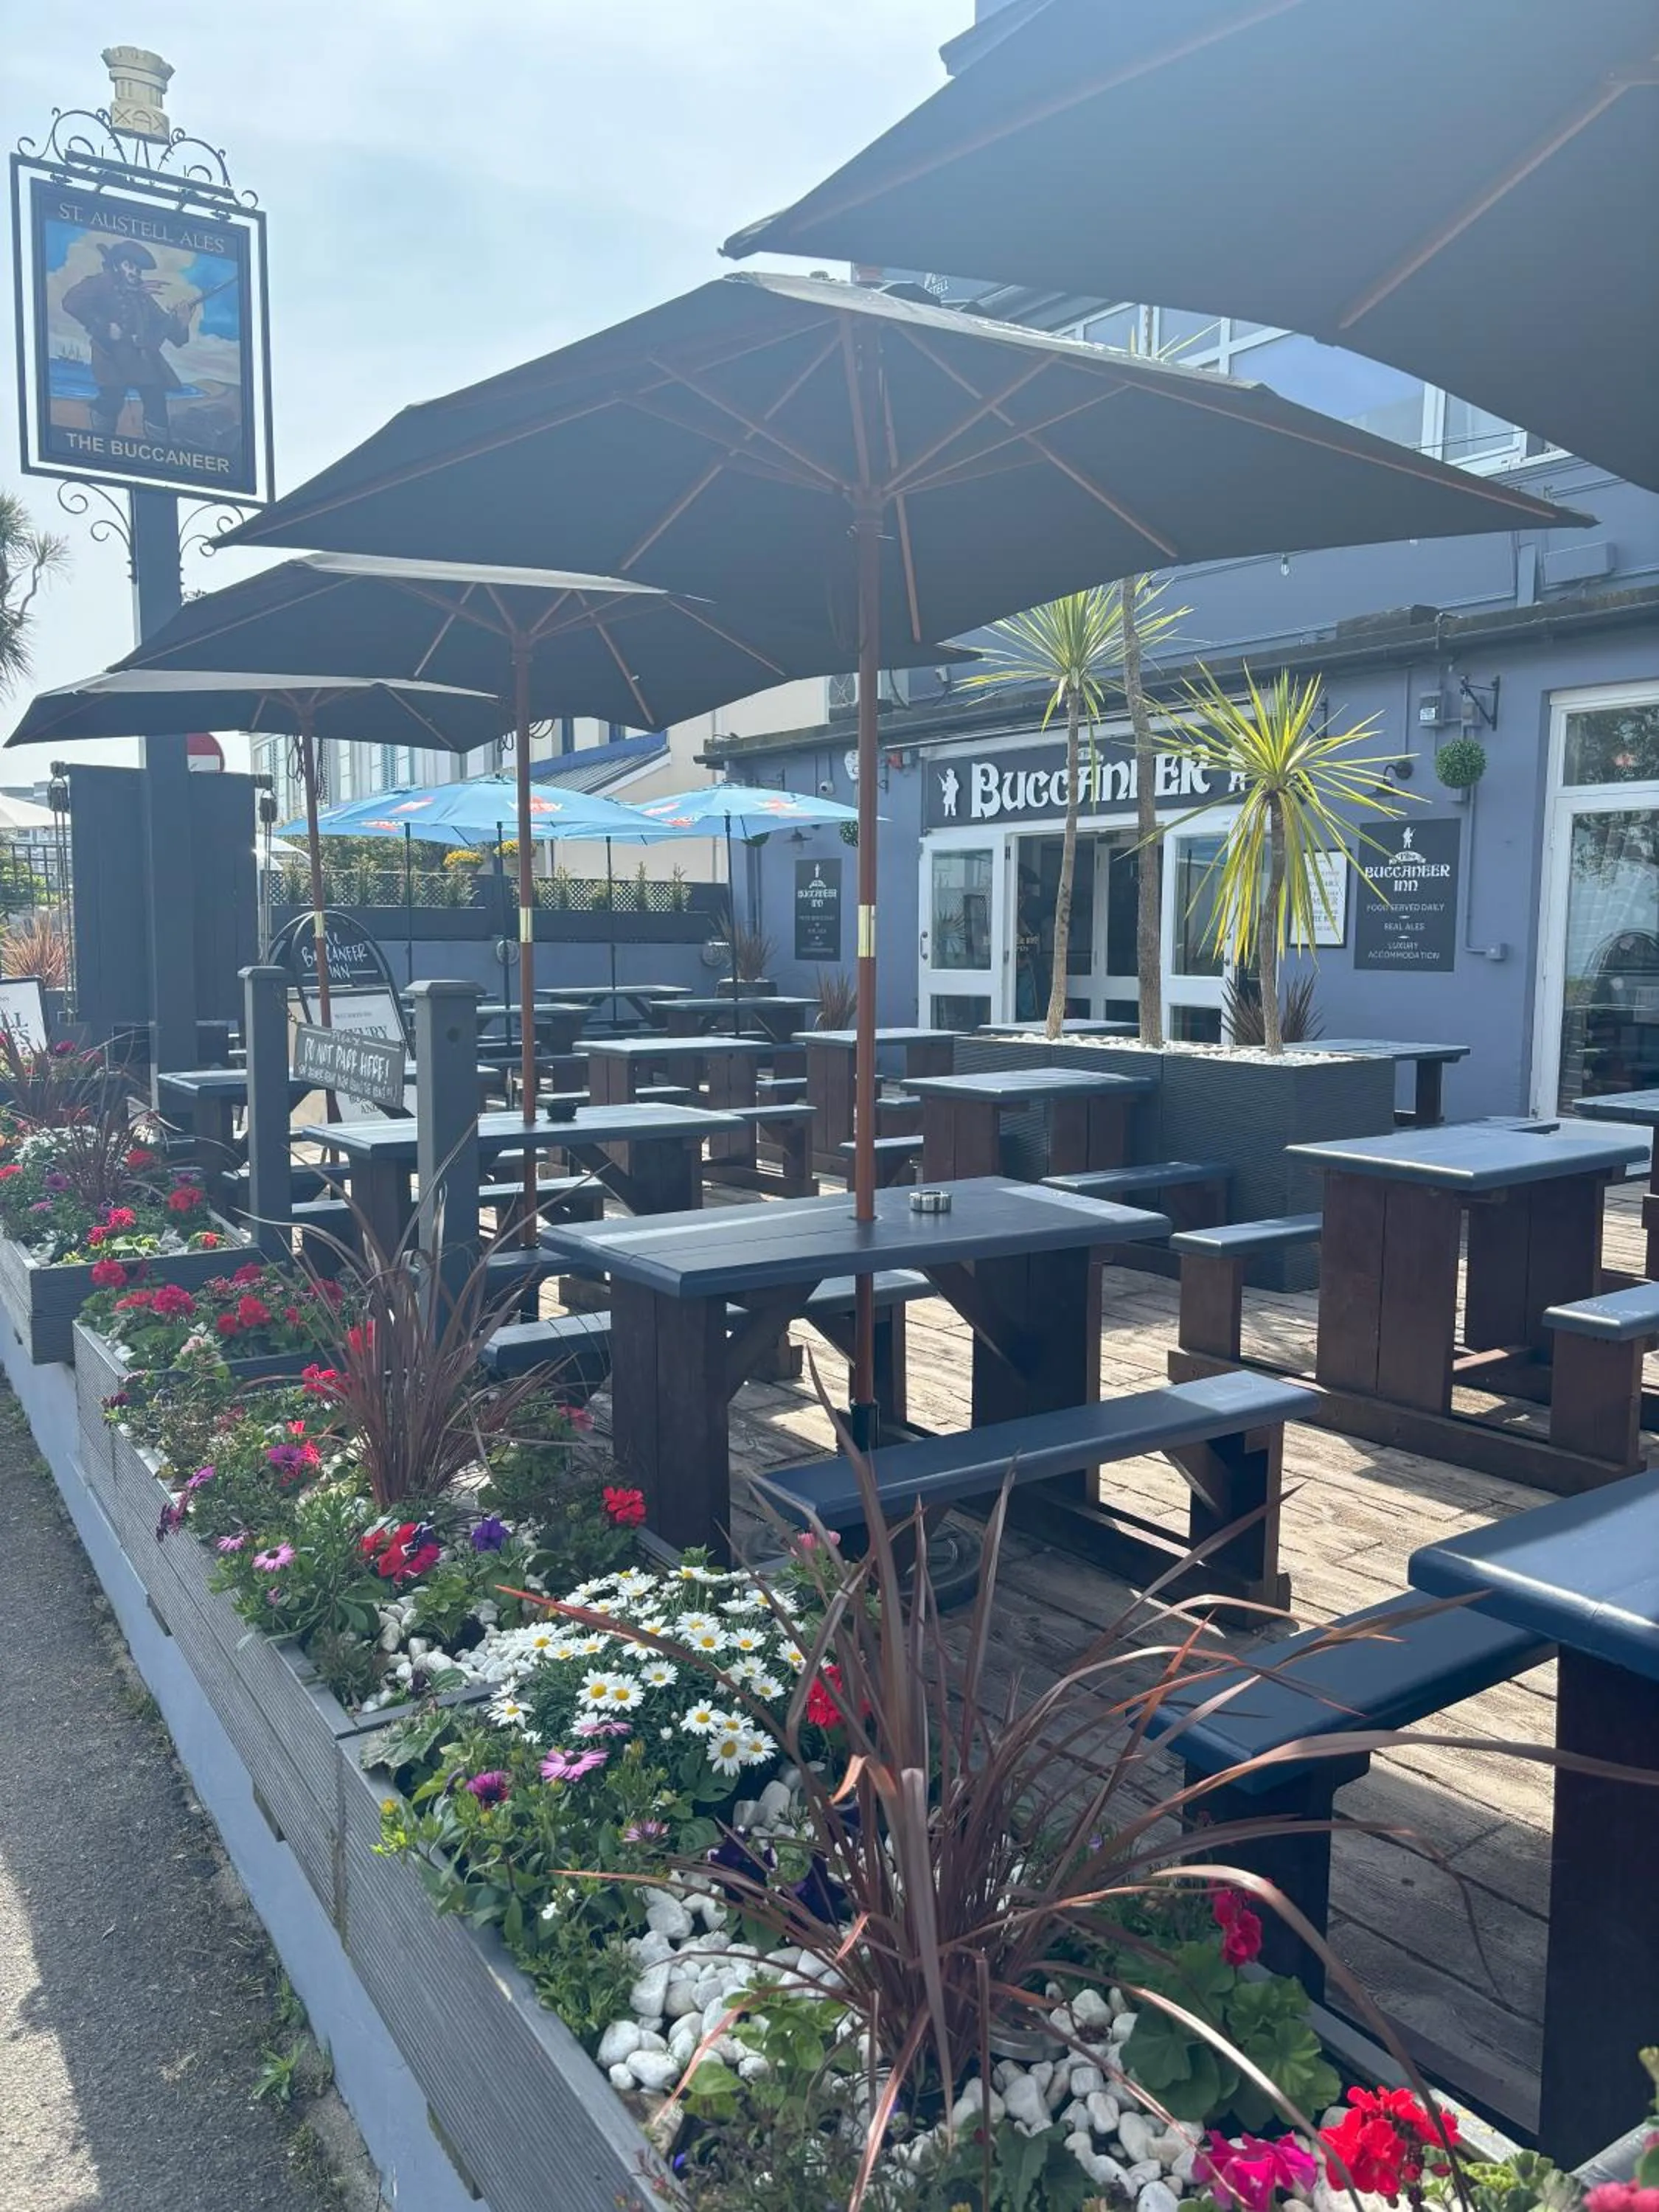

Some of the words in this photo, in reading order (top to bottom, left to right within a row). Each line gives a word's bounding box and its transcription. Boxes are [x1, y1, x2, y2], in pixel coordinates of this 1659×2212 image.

[58, 202, 83, 222] ST.
[90, 212, 173, 242] AUSTELL
[180, 232, 225, 253] ALES
[66, 432, 105, 453] THE
[111, 440, 230, 473] BUCCANEER
[1365, 864, 1450, 878] BUCCANEER
[1394, 880, 1419, 892] INN
[1392, 903, 1421, 912] SERVED
[1421, 902, 1444, 912] DAILY
[1384, 922, 1402, 931] REAL
[1405, 922, 1425, 931] ALES
[1388, 942, 1418, 950] LUXURY
[1368, 950, 1440, 960] ACCOMMODATION
[329, 963, 350, 979] INN
[316, 1041, 334, 1065] NOT
[335, 1045, 358, 1074] PARK
